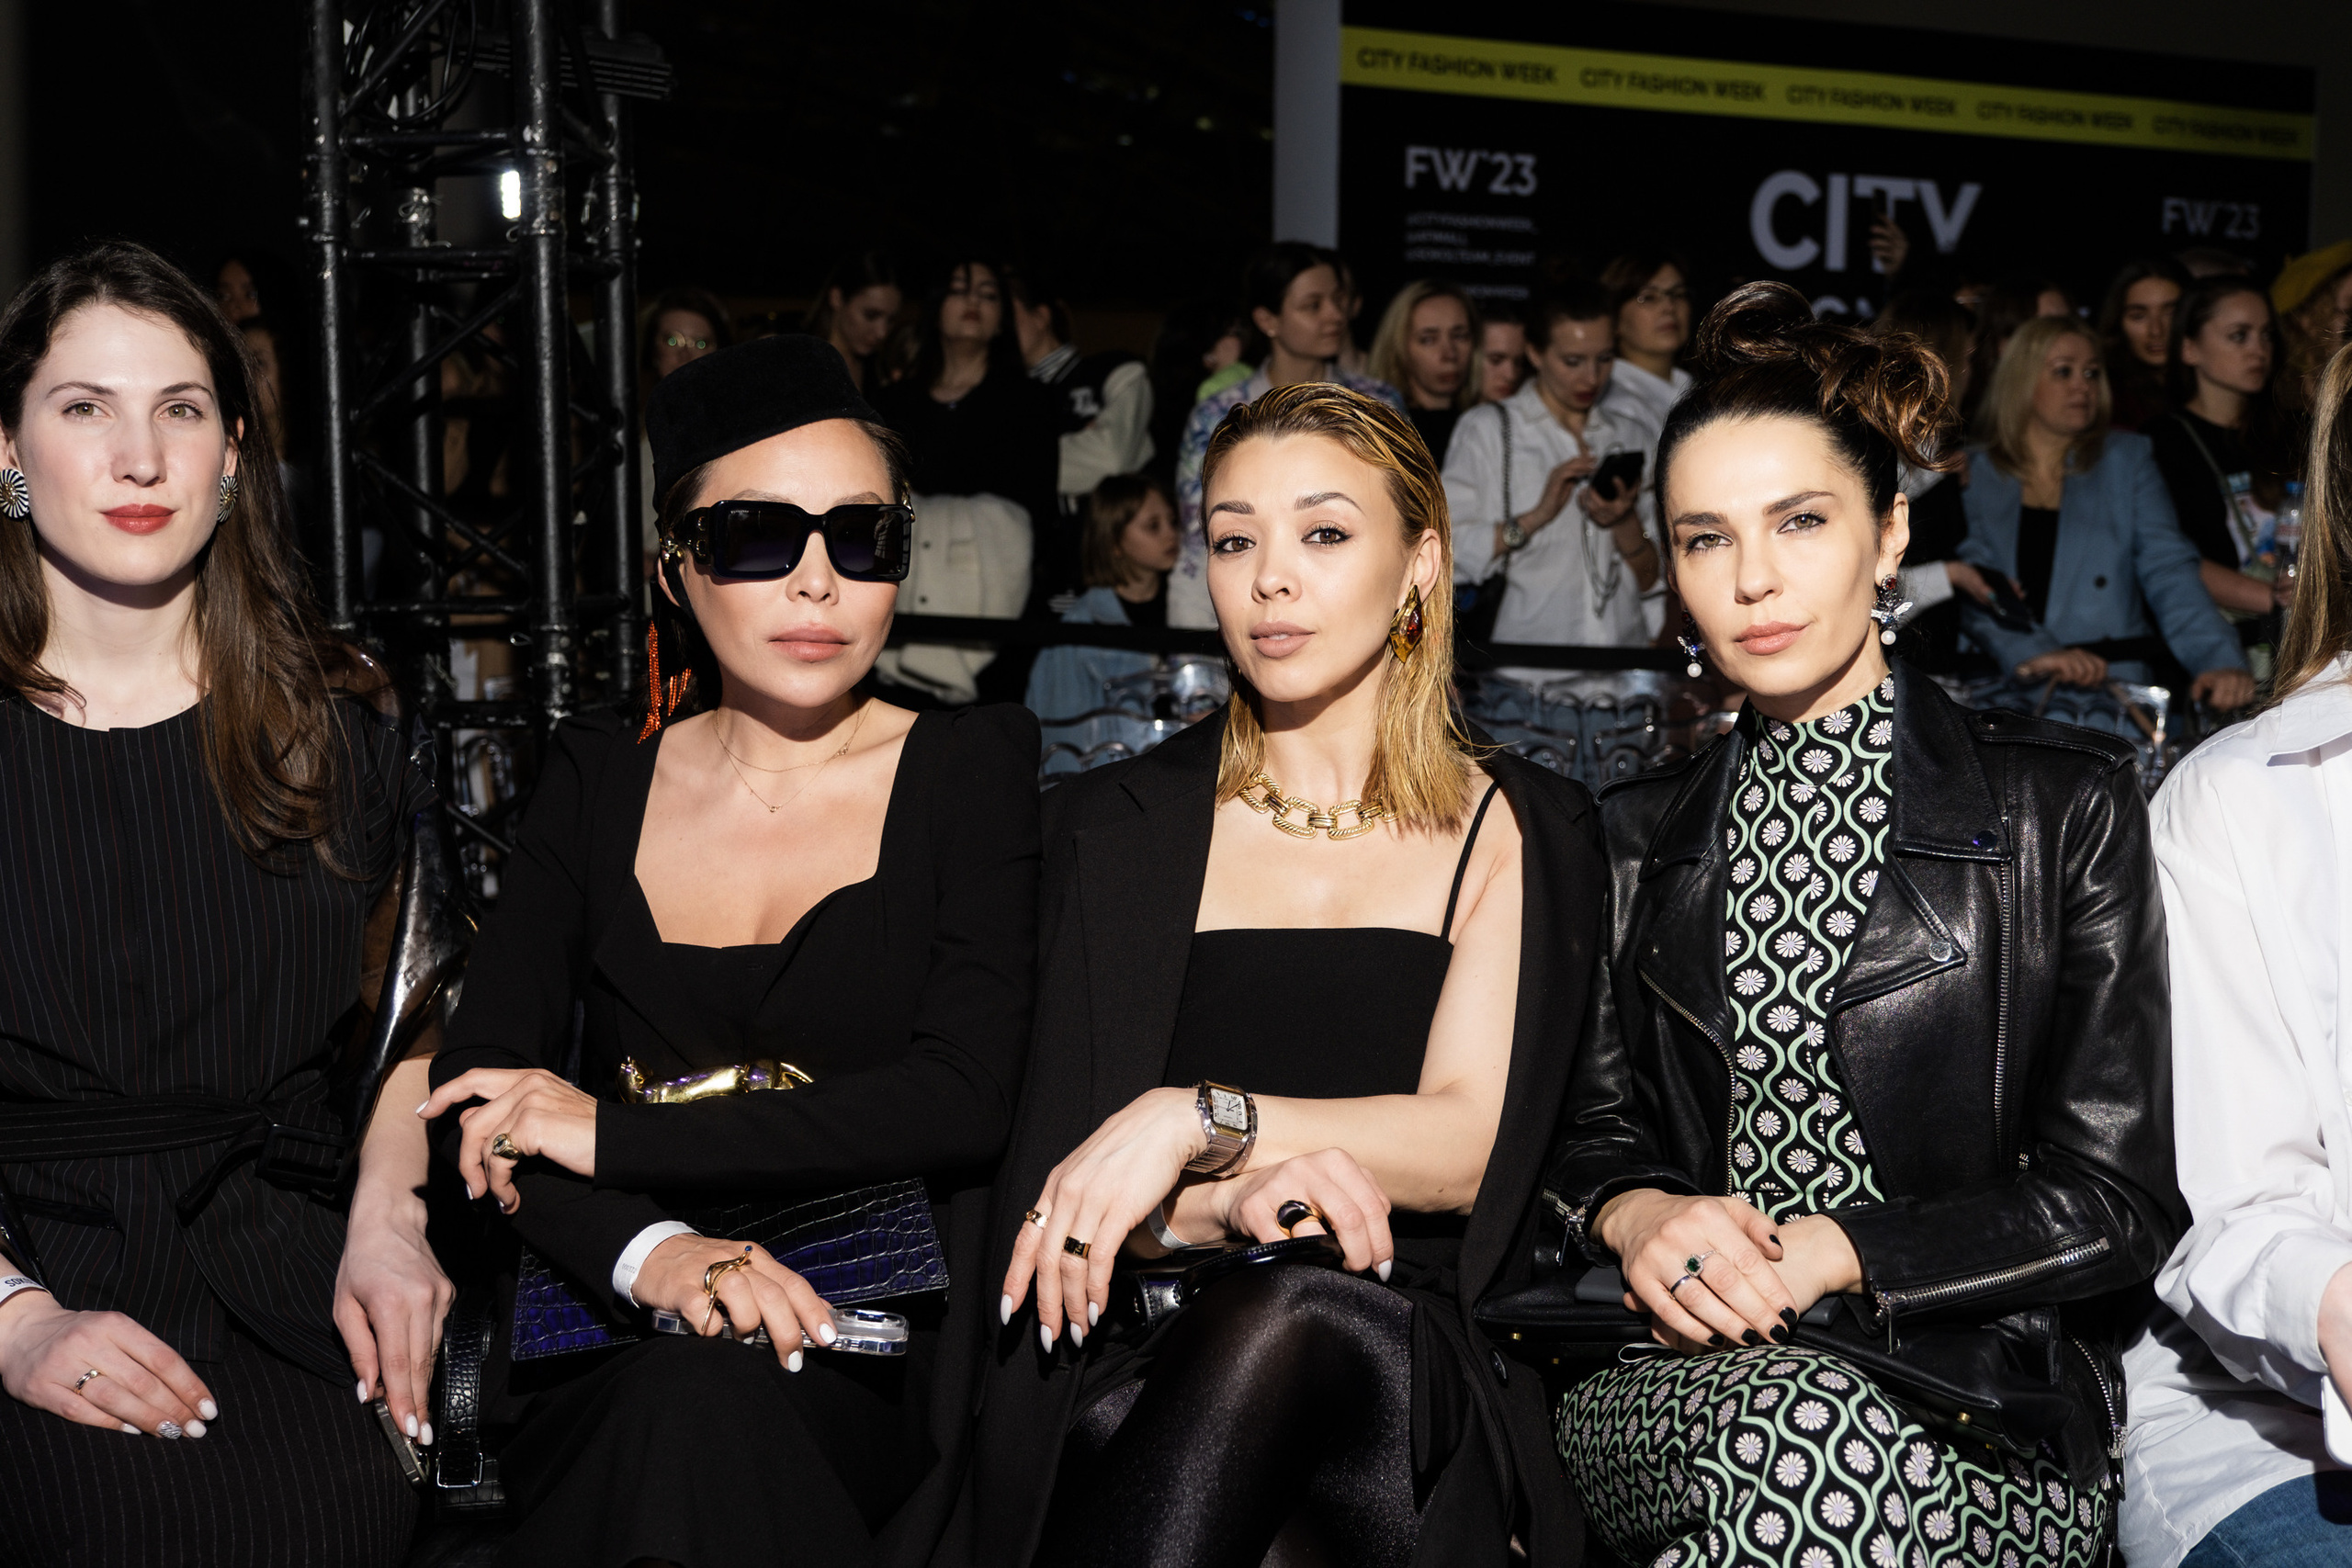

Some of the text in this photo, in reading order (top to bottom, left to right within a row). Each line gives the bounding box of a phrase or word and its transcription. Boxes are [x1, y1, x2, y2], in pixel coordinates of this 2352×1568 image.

[1356, 47, 1558, 85] CITY FASHION WEEK
[1579, 67, 1766, 101] CITY FASHION WEEK
[1785, 85, 1957, 118] CITY FASHION WEEK
